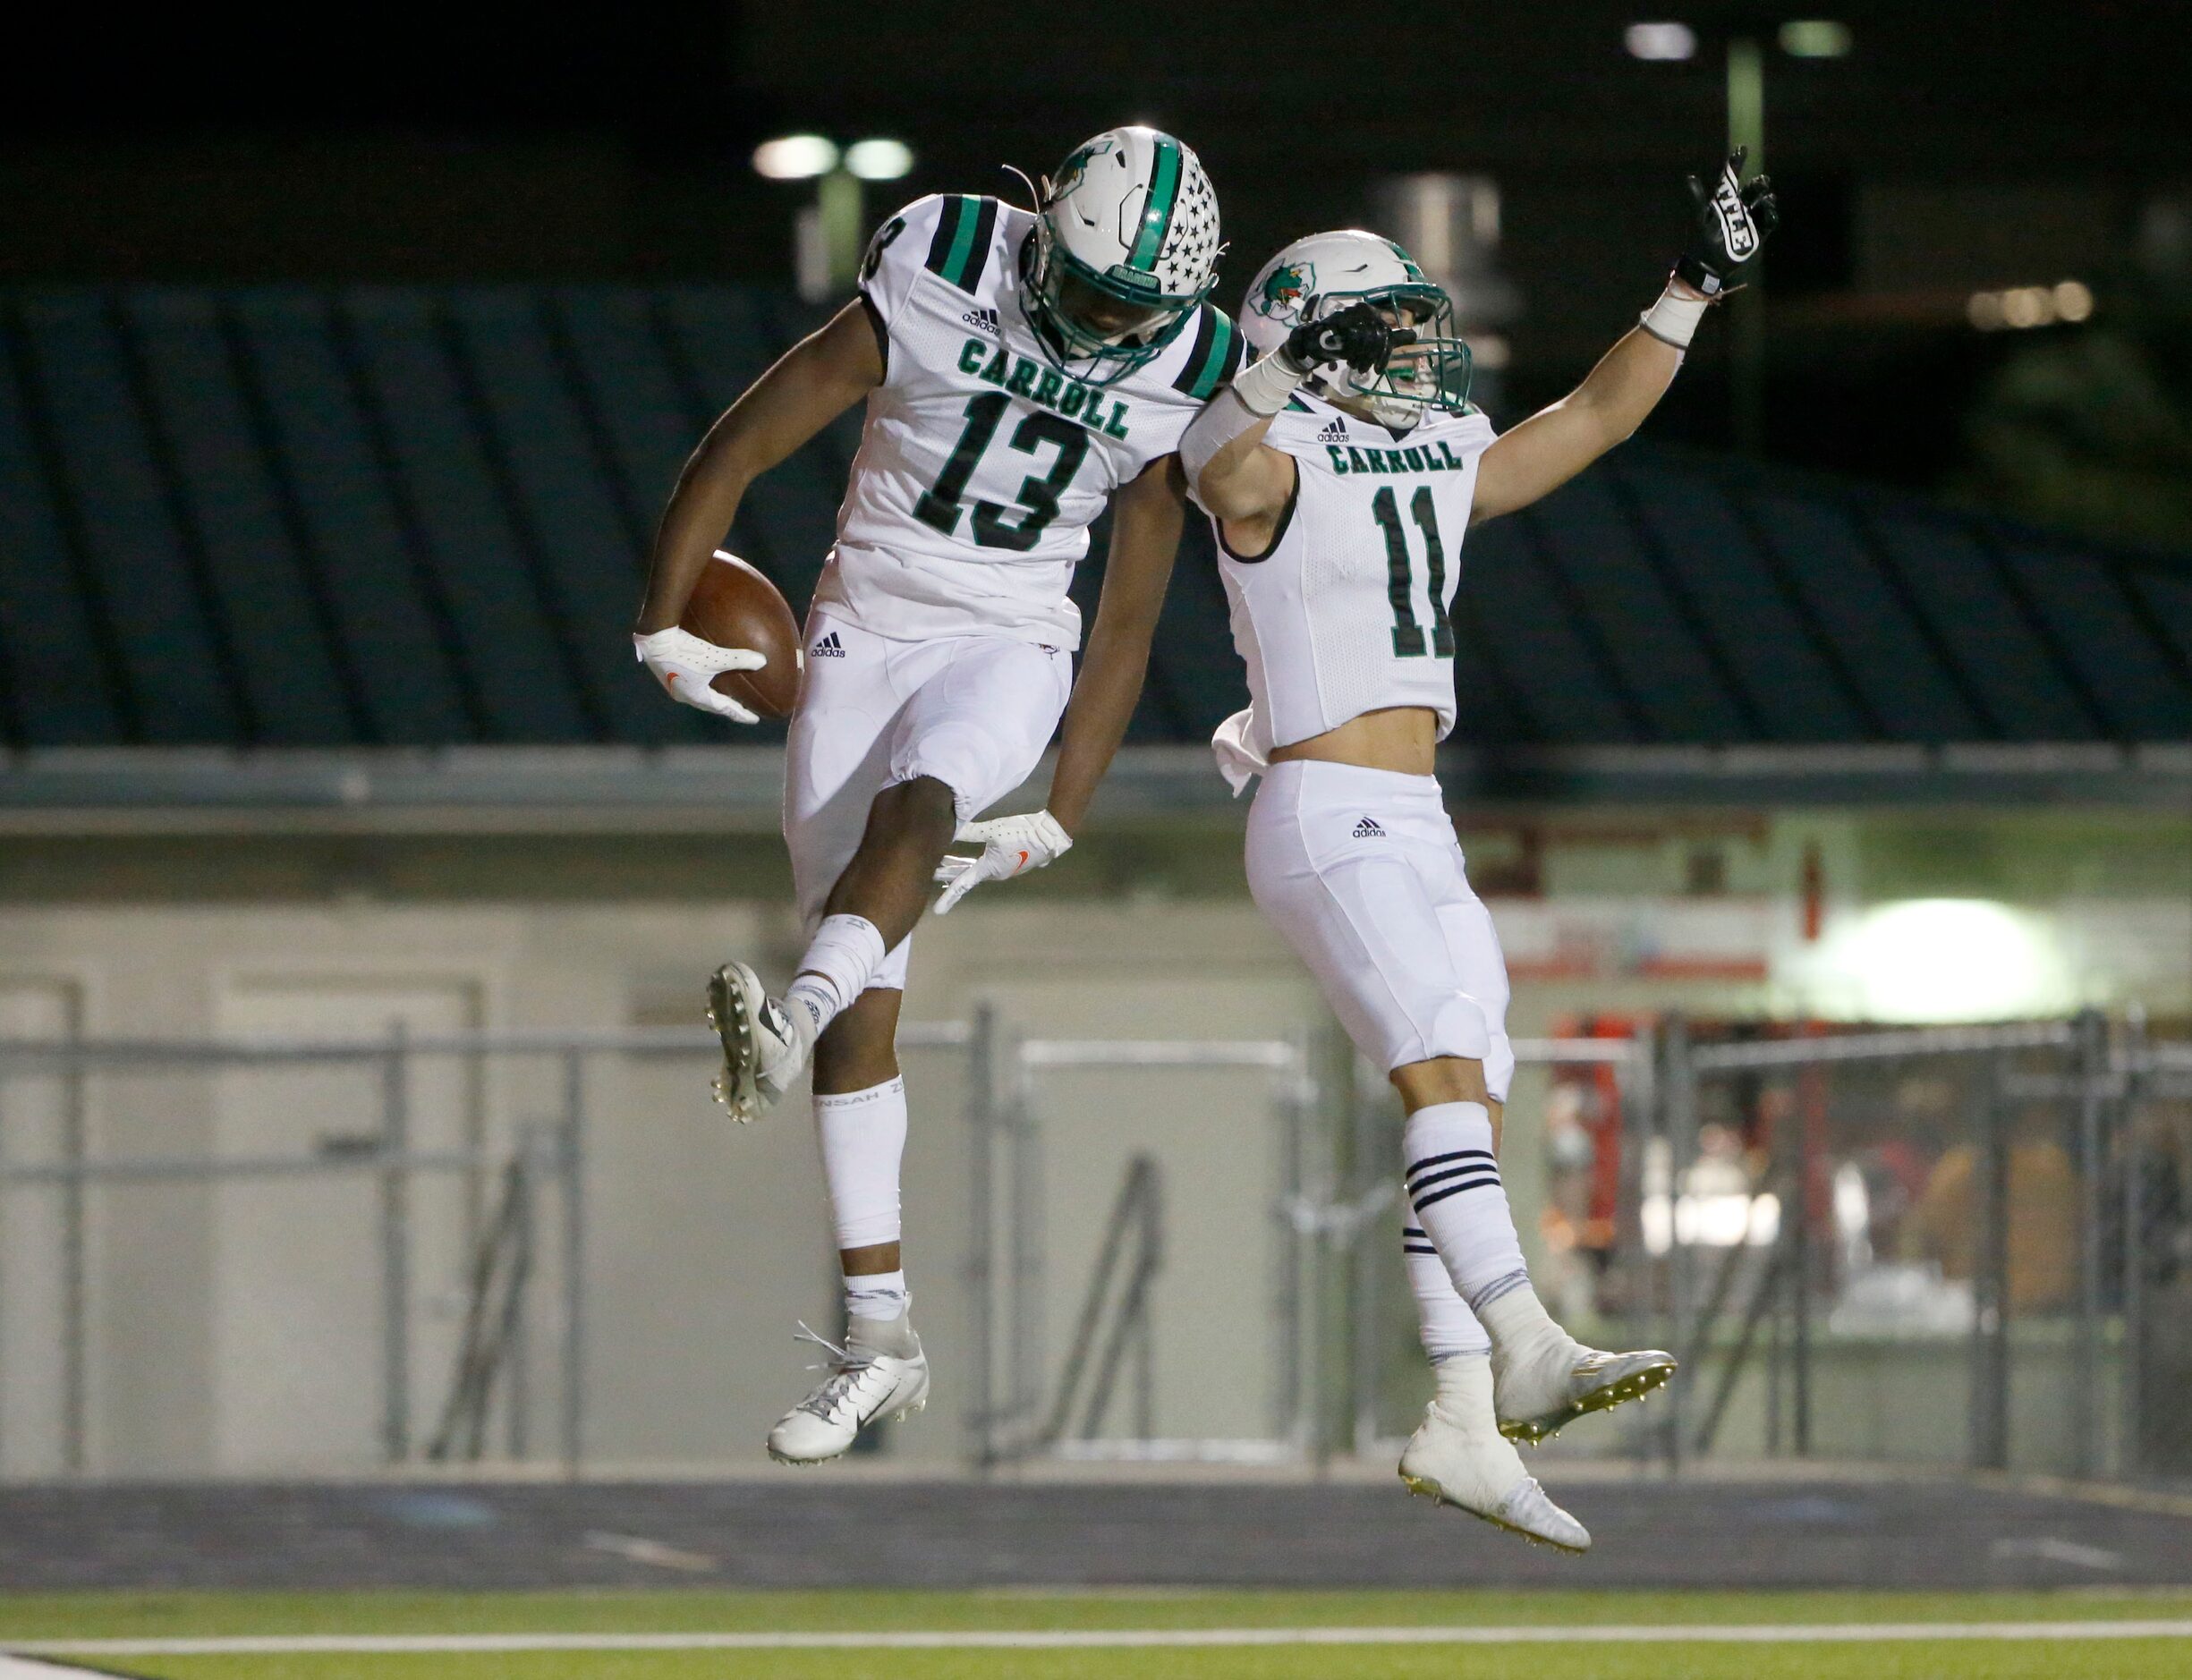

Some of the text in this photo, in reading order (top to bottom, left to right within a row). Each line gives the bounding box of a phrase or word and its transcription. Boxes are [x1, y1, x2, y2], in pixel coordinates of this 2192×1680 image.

[962, 312, 1002, 336] adidas
[957, 338, 1129, 441] CARROLL
[1316, 431, 1350, 443] adidas
[912, 390, 1090, 551] 13
[1372, 486, 1456, 658] 11
[811, 646, 846, 658] adidas
[1352, 827, 1387, 838] adidas
